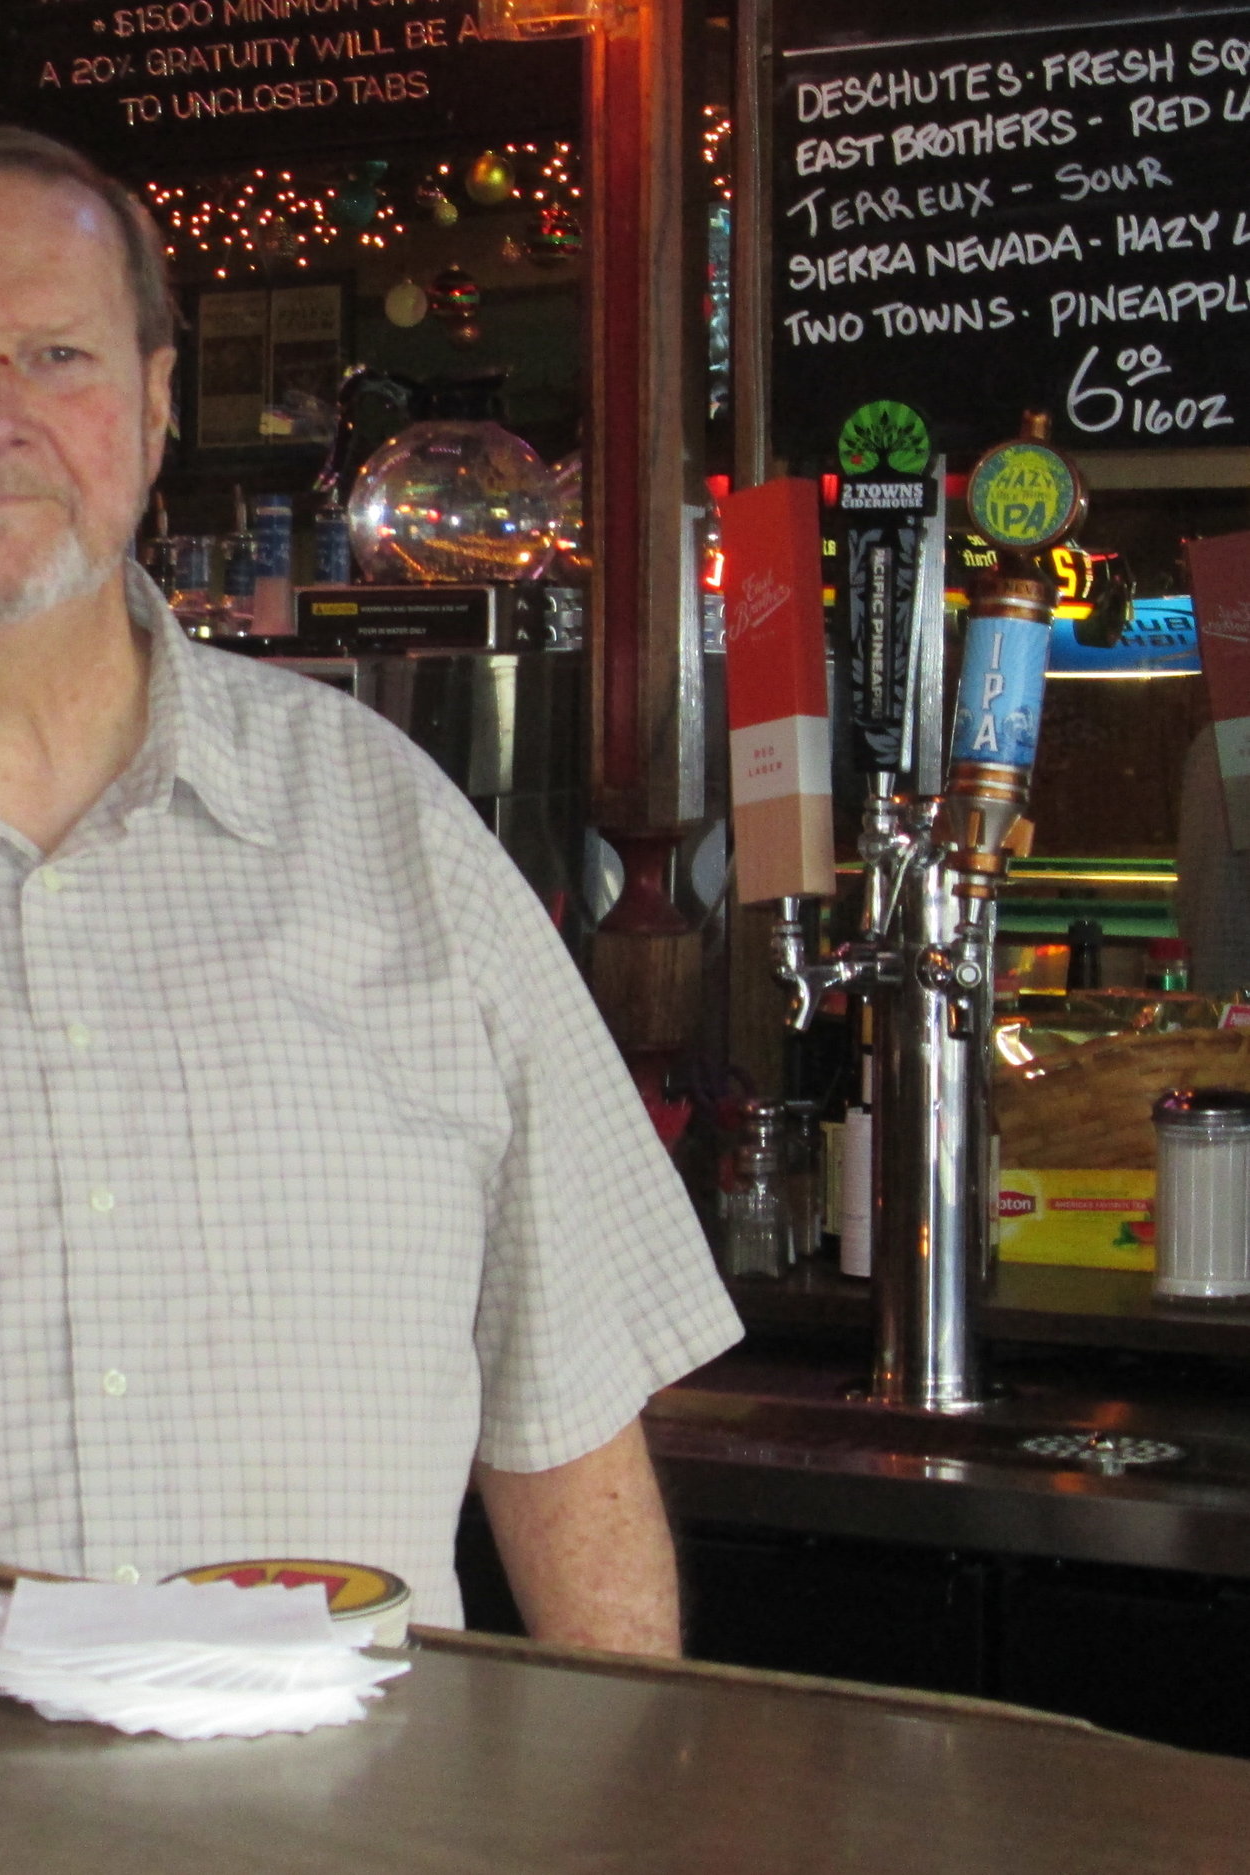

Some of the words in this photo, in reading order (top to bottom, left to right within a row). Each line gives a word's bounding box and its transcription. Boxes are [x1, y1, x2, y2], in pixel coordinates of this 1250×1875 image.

[39, 60, 62, 89] A
[71, 54, 134, 86] 20%
[146, 38, 300, 77] GRATUITY
[310, 28, 395, 61] WILL
[404, 18, 448, 50] BE
[796, 60, 1023, 123] DESCHUTES
[1041, 42, 1175, 91] FRESH
[119, 94, 163, 126] TO
[172, 79, 339, 119] UNCLOSED
[343, 70, 431, 105] TABS
[795, 133, 885, 176] EAST
[890, 107, 1078, 166] BROTHERS
[1129, 95, 1211, 137] RED
[786, 178, 994, 237] TERREUX
[1055, 156, 1173, 201] SOUR
[789, 242, 916, 291] SIERRA
[926, 224, 1083, 277] NEVADA
[1116, 210, 1220, 256] HAZY
[783, 310, 864, 347] TWO
[872, 296, 1015, 338] TOWNS
[842, 498, 923, 509] CIDERHOUSE
[843, 483, 852, 498] 2
[856, 483, 923, 499] TOWNS
[990, 500, 1047, 533] IPA
